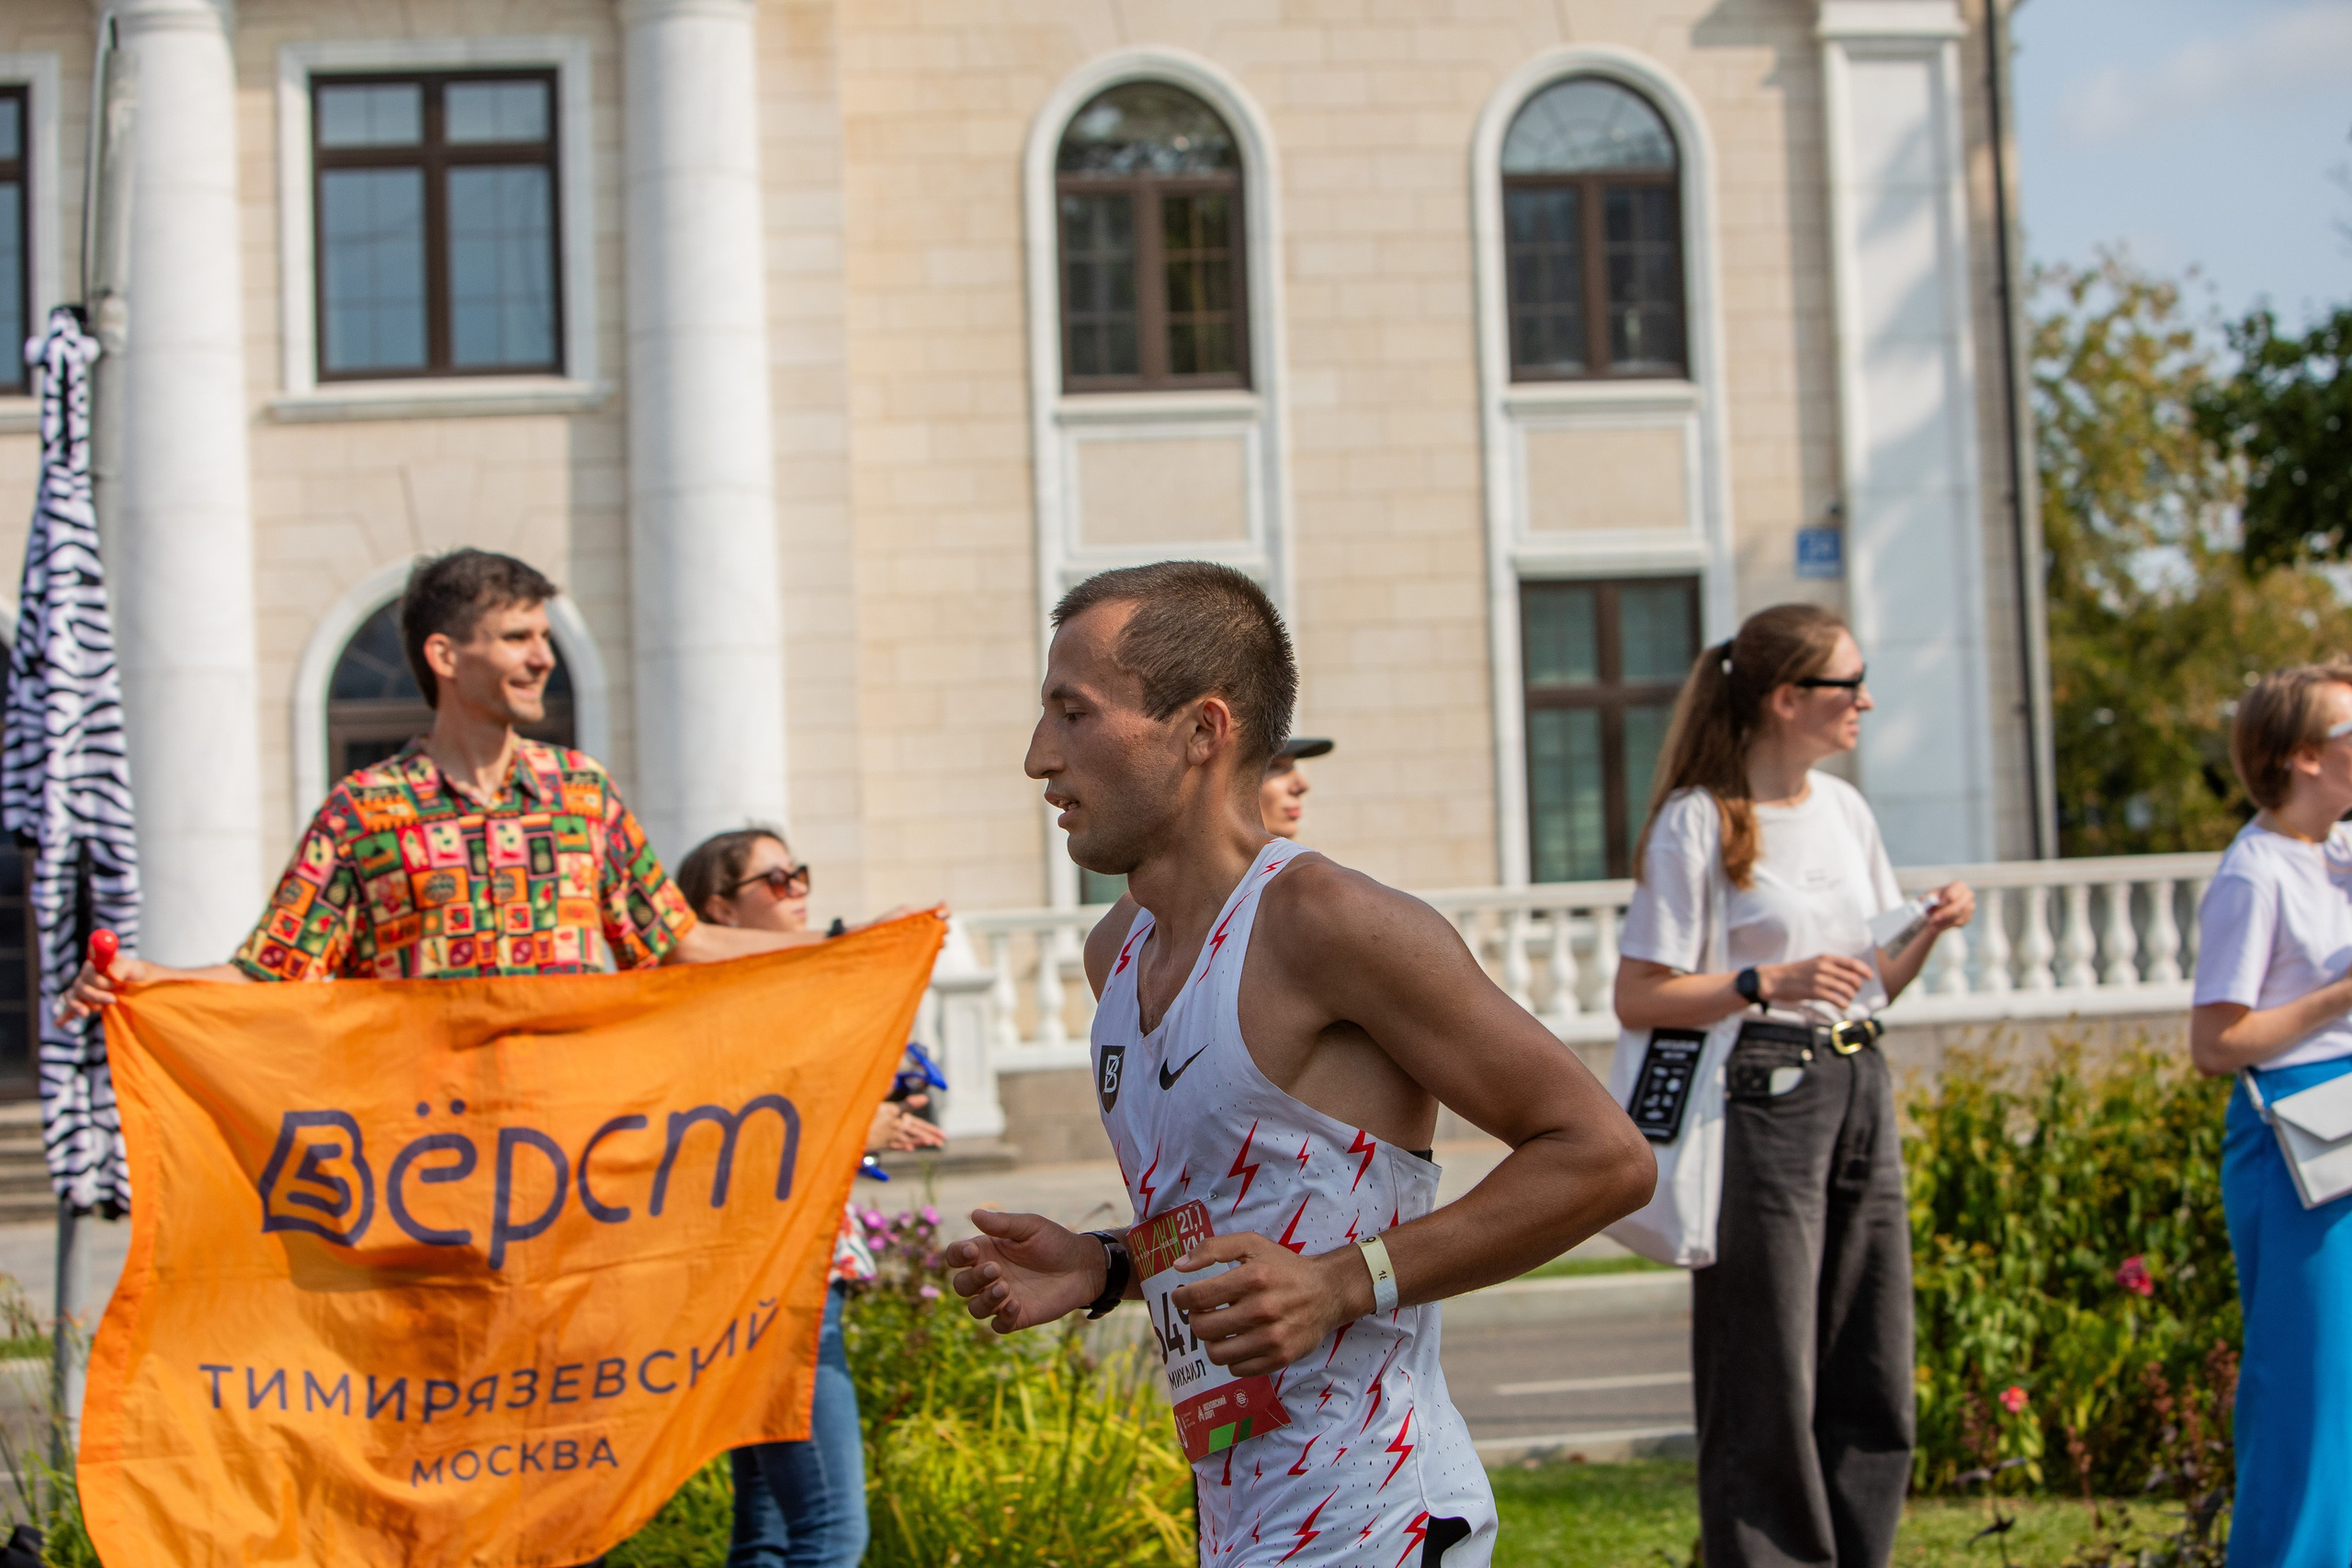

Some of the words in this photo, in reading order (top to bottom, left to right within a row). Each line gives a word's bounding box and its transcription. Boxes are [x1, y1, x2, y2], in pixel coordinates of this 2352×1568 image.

[1177, 1205, 1203, 1234] 21,1
[1168, 1359, 1206, 1391] МИХАИЛ
[410, 1436, 620, 1488] МОСКВА
